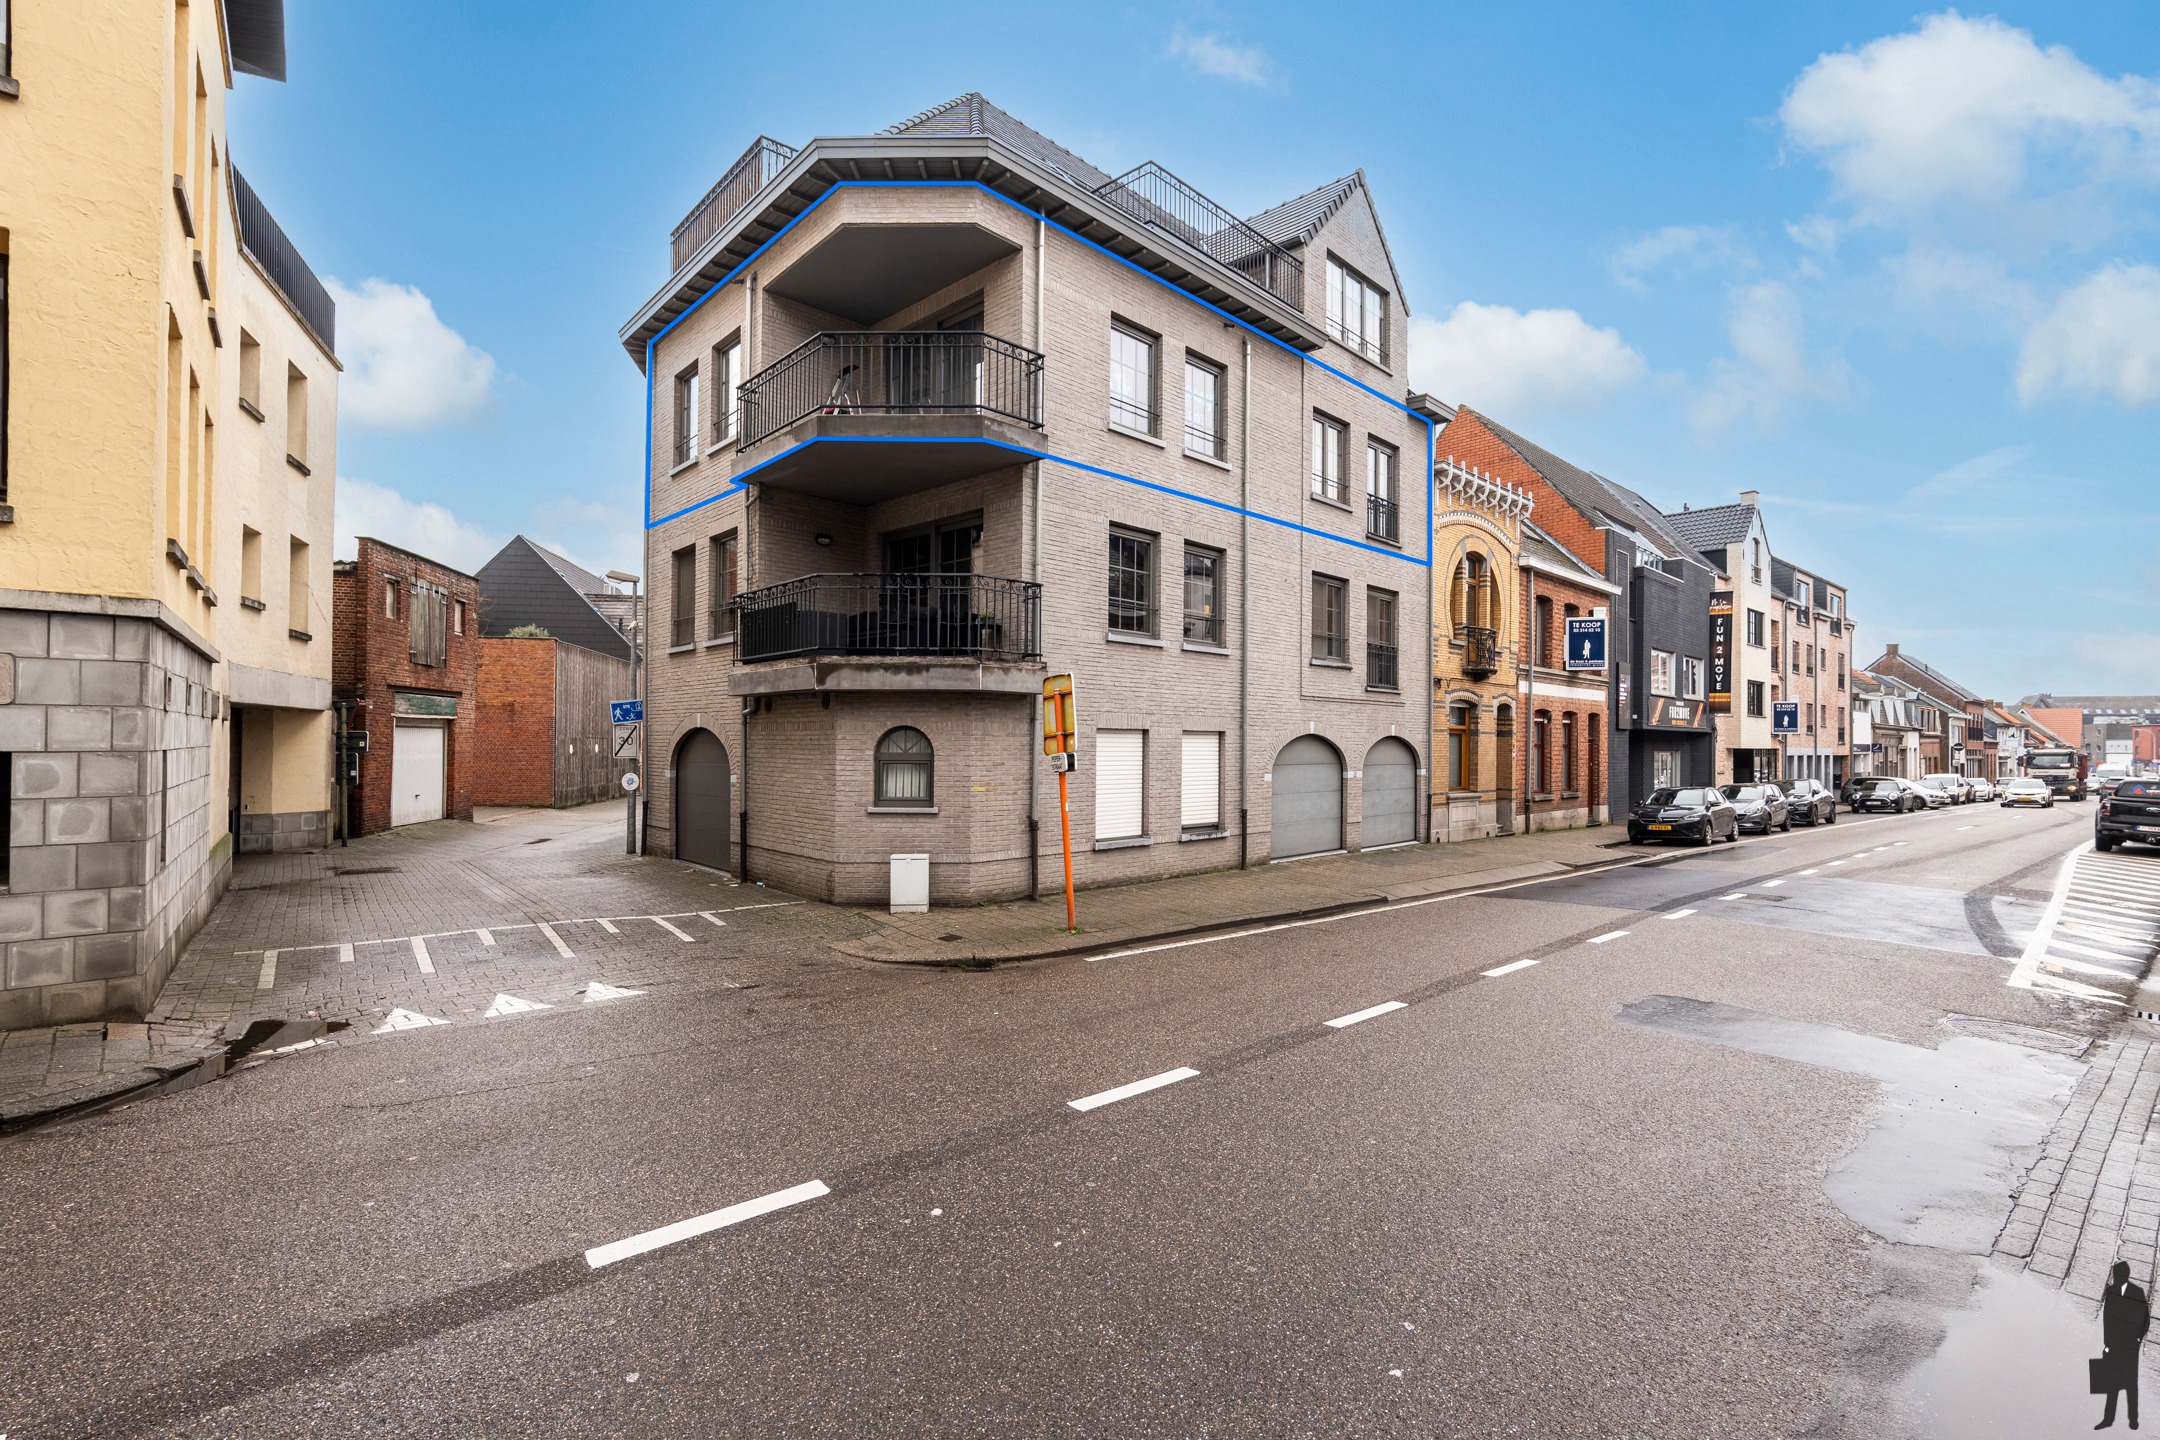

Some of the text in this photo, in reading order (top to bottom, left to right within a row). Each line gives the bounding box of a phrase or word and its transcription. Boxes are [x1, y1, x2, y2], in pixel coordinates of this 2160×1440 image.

[1714, 618, 1724, 690] FUN 2 MOVE
[618, 736, 634, 746] 30
